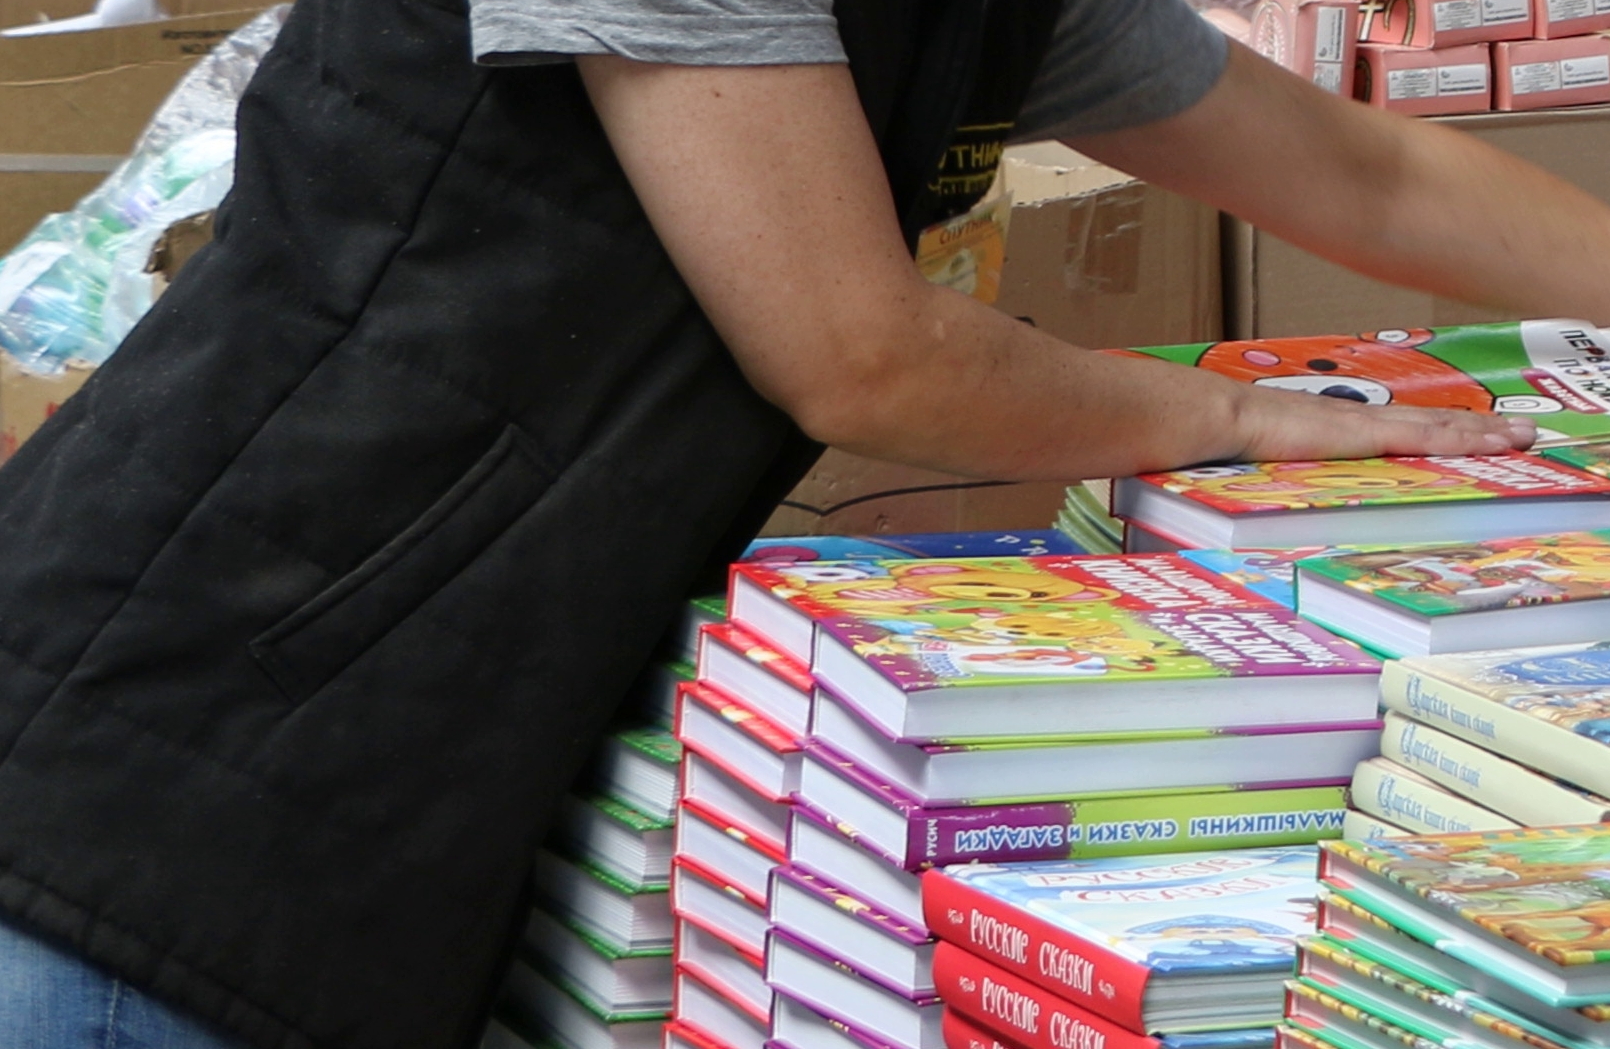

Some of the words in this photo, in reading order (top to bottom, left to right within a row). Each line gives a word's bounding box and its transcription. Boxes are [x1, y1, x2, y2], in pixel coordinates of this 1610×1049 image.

[1183, 611, 1291, 664] СКАЗКИ
[954, 823, 1064, 853] ЗАГАДКИ
[1087, 817, 1178, 844] СКАЗКИ
[1075, 874, 1289, 903] СКАЗКИ
[1038, 940, 1095, 996] СКАЗКИ
